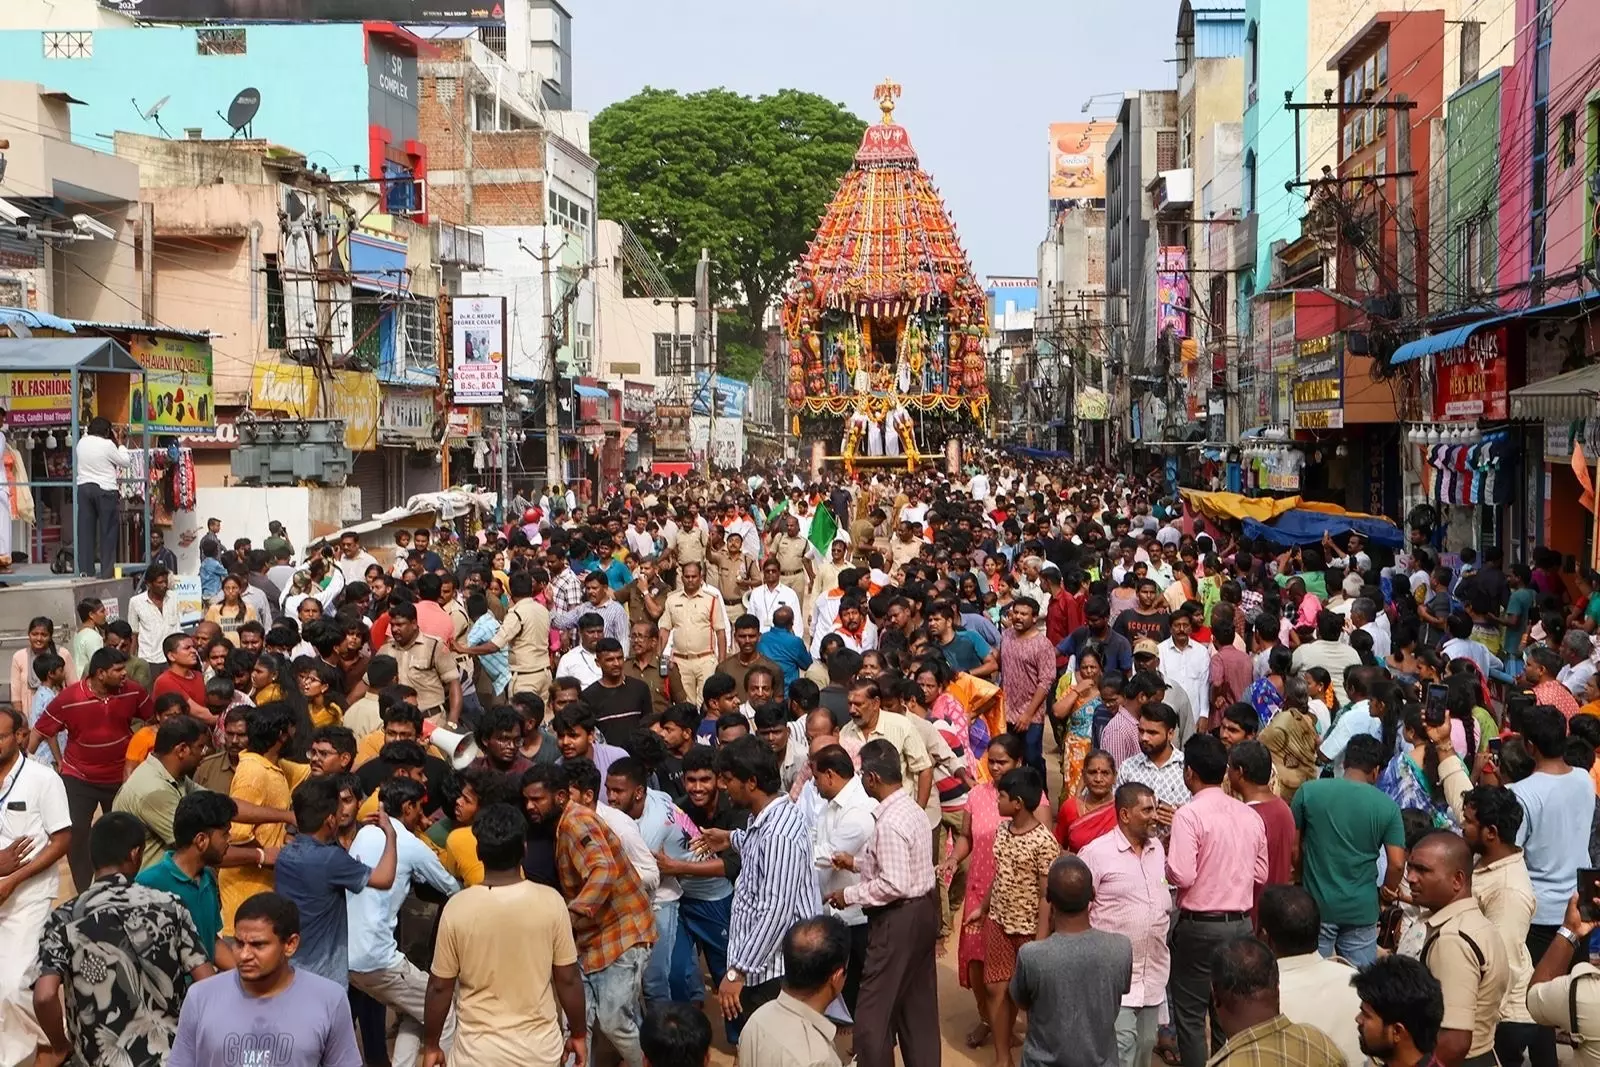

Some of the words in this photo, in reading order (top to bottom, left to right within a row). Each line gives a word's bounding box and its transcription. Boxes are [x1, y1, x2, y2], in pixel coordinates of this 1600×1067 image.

[392, 54, 403, 78] SR
[380, 73, 409, 100] COMPLEX
[991, 279, 1037, 287] Ananda
[1469, 331, 1499, 371] Styles
[140, 353, 172, 371] BHAVANI
[28, 379, 72, 396] FASHIONS
[481, 381, 496, 390] BCA
[1450, 375, 1466, 396] MENS
[1466, 373, 1486, 394] WEAR
[223, 1031, 295, 1067] GOOD
[243, 1050, 270, 1064] TAKE
